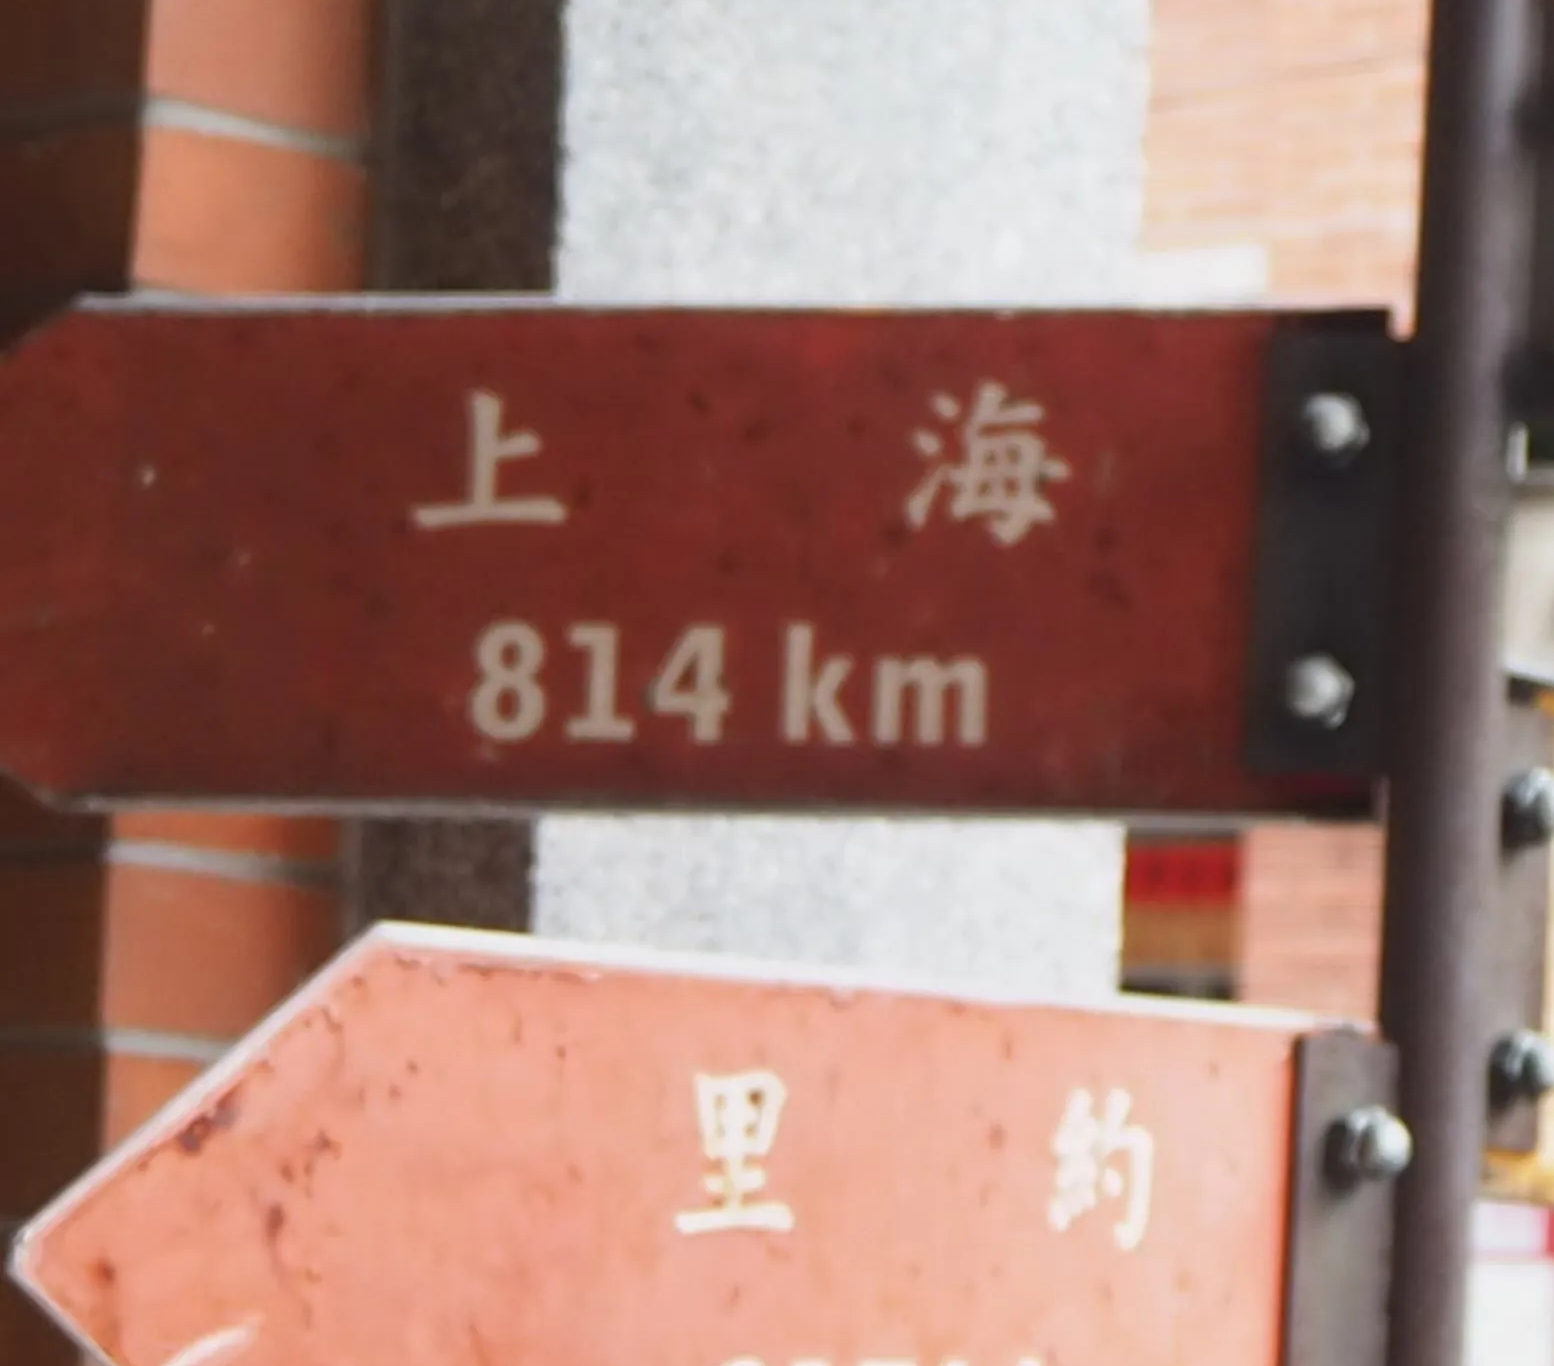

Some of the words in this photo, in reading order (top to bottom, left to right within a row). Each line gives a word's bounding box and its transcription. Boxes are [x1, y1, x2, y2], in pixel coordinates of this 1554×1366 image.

[411, 381, 1070, 545] 上海
[468, 621, 732, 744] 814
[781, 623, 989, 746] km
[673, 1068, 1156, 1251] 里約
